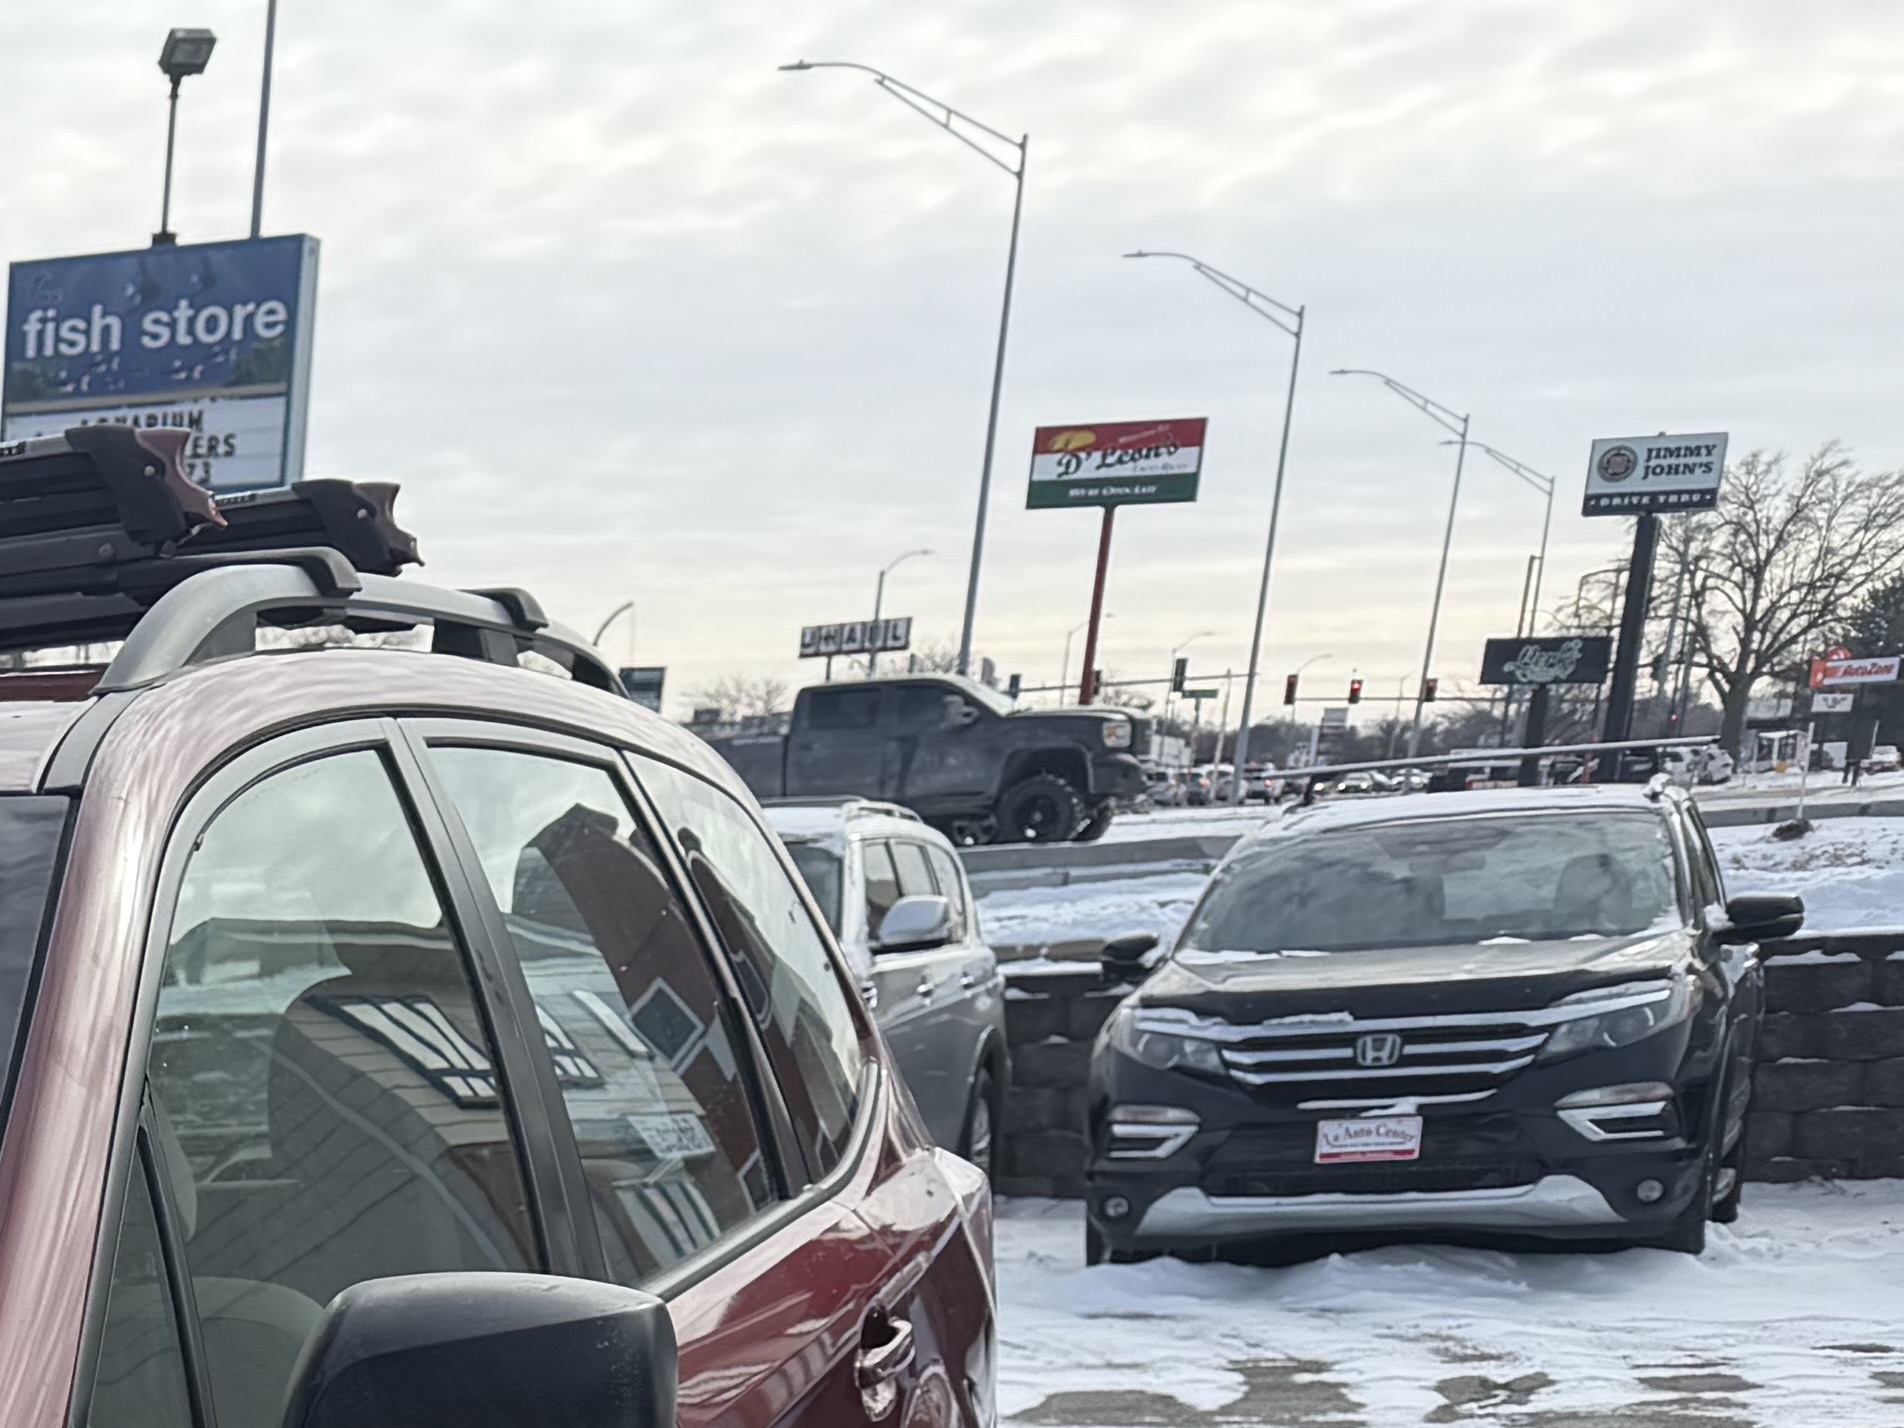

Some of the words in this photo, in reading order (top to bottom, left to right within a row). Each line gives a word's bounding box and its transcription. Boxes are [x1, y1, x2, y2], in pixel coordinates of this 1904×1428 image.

[22, 303, 122, 359] fish
[141, 298, 288, 348] store
[1645, 444, 1717, 463] JIMMY
[1642, 461, 1714, 480] JOHN'S
